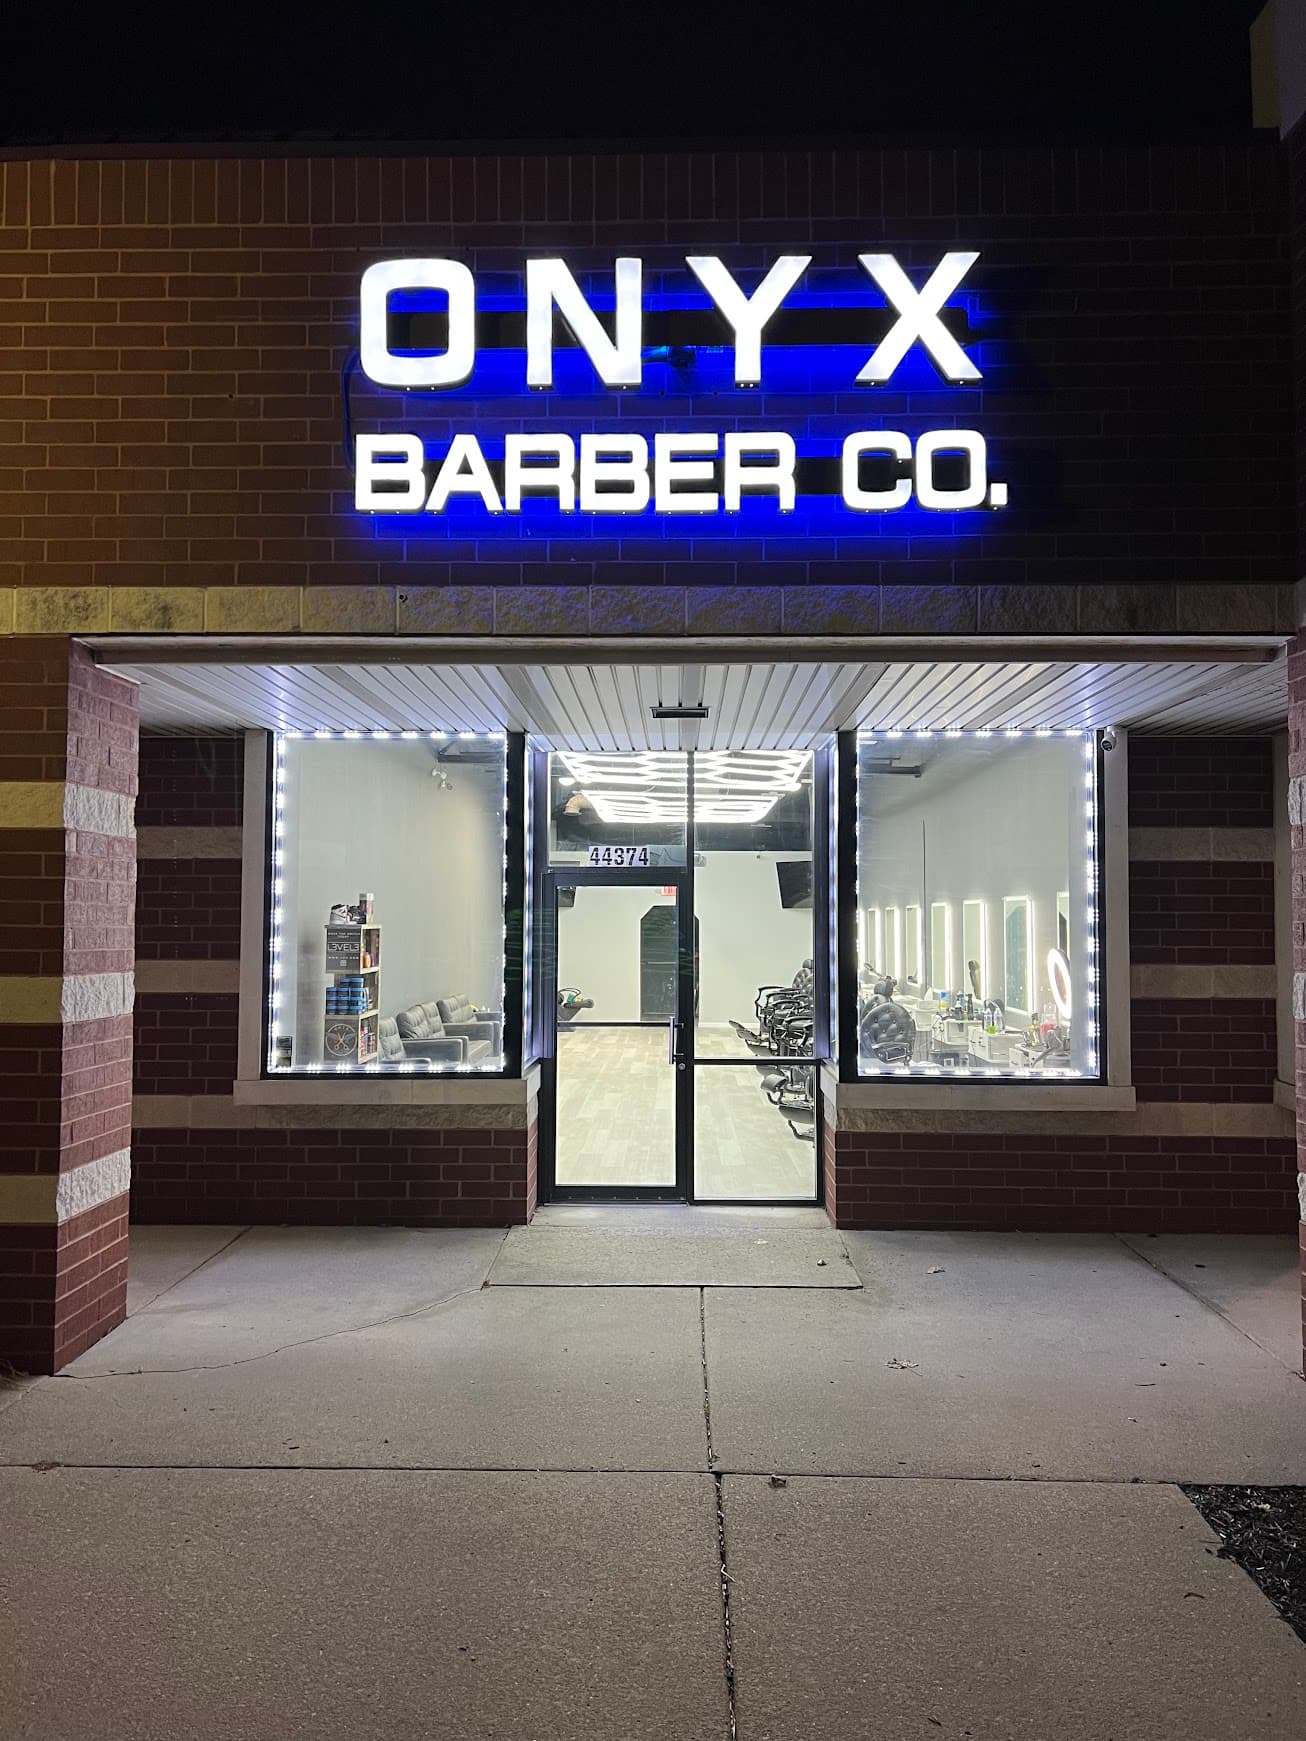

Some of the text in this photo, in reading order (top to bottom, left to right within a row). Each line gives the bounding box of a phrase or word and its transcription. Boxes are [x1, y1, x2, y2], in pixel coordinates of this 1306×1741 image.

[360, 252, 984, 388] ONYX
[354, 429, 1008, 514] BARBER CO.
[590, 847, 649, 866] 44374
